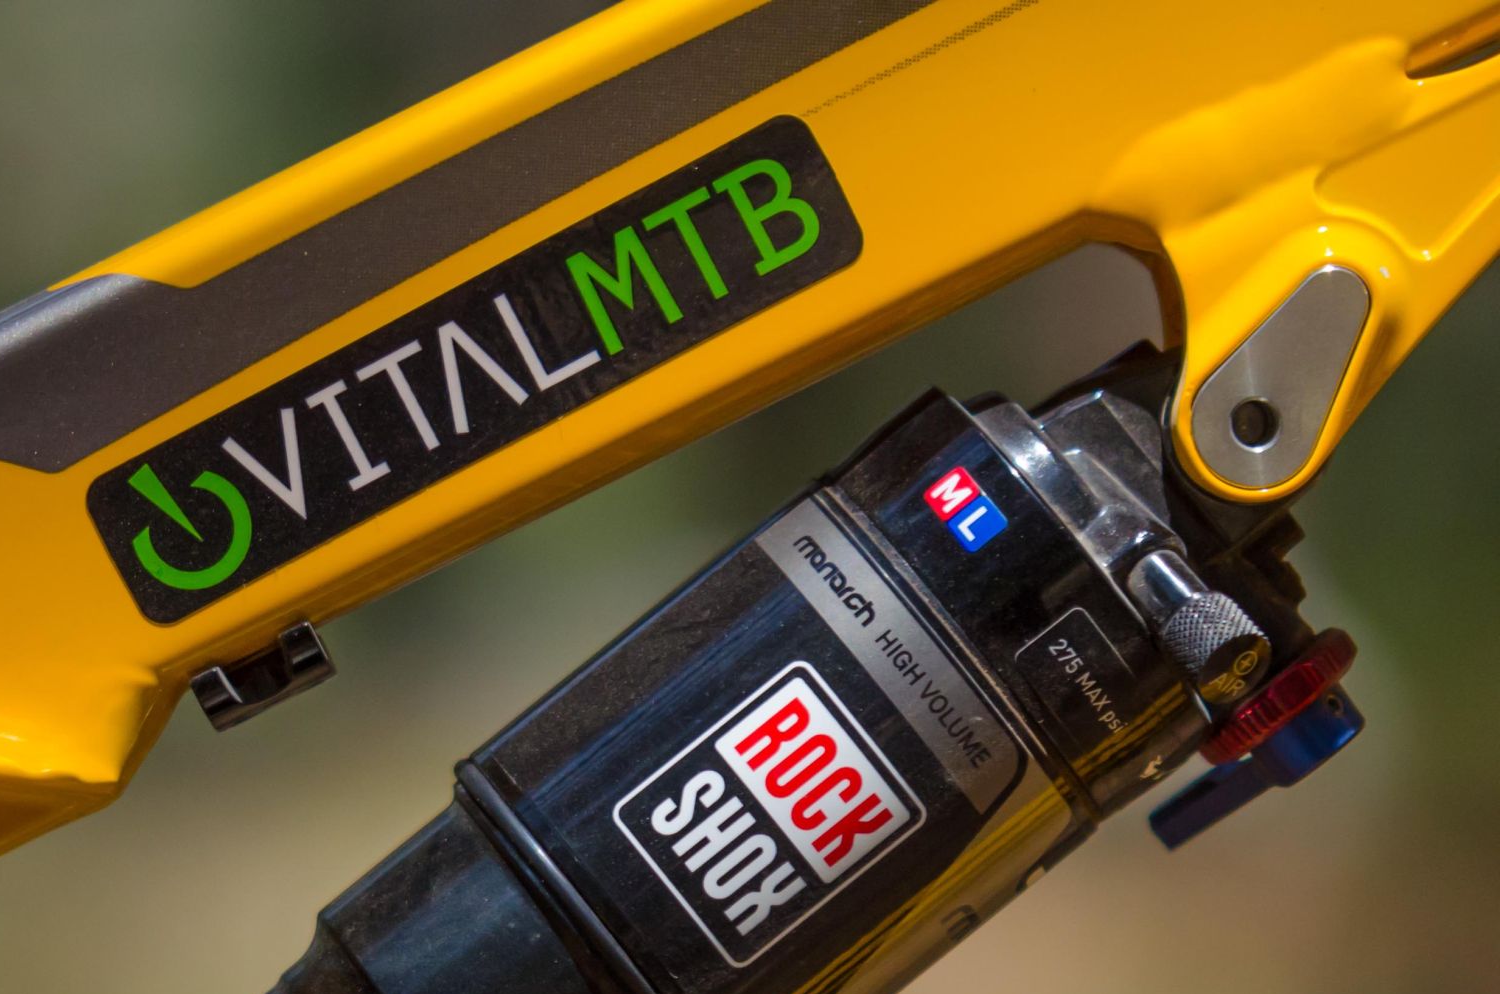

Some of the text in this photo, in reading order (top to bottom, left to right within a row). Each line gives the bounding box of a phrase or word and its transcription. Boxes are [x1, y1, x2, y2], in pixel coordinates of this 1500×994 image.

[221, 158, 821, 521] VITALMTB
[793, 535, 992, 768] monarch HIGH VOLUME
[1048, 638, 1128, 734] 275 MAX psi
[1208, 673, 1246, 697] AIR
[651, 769, 807, 937] SHOX
[734, 697, 894, 868] ROCK
